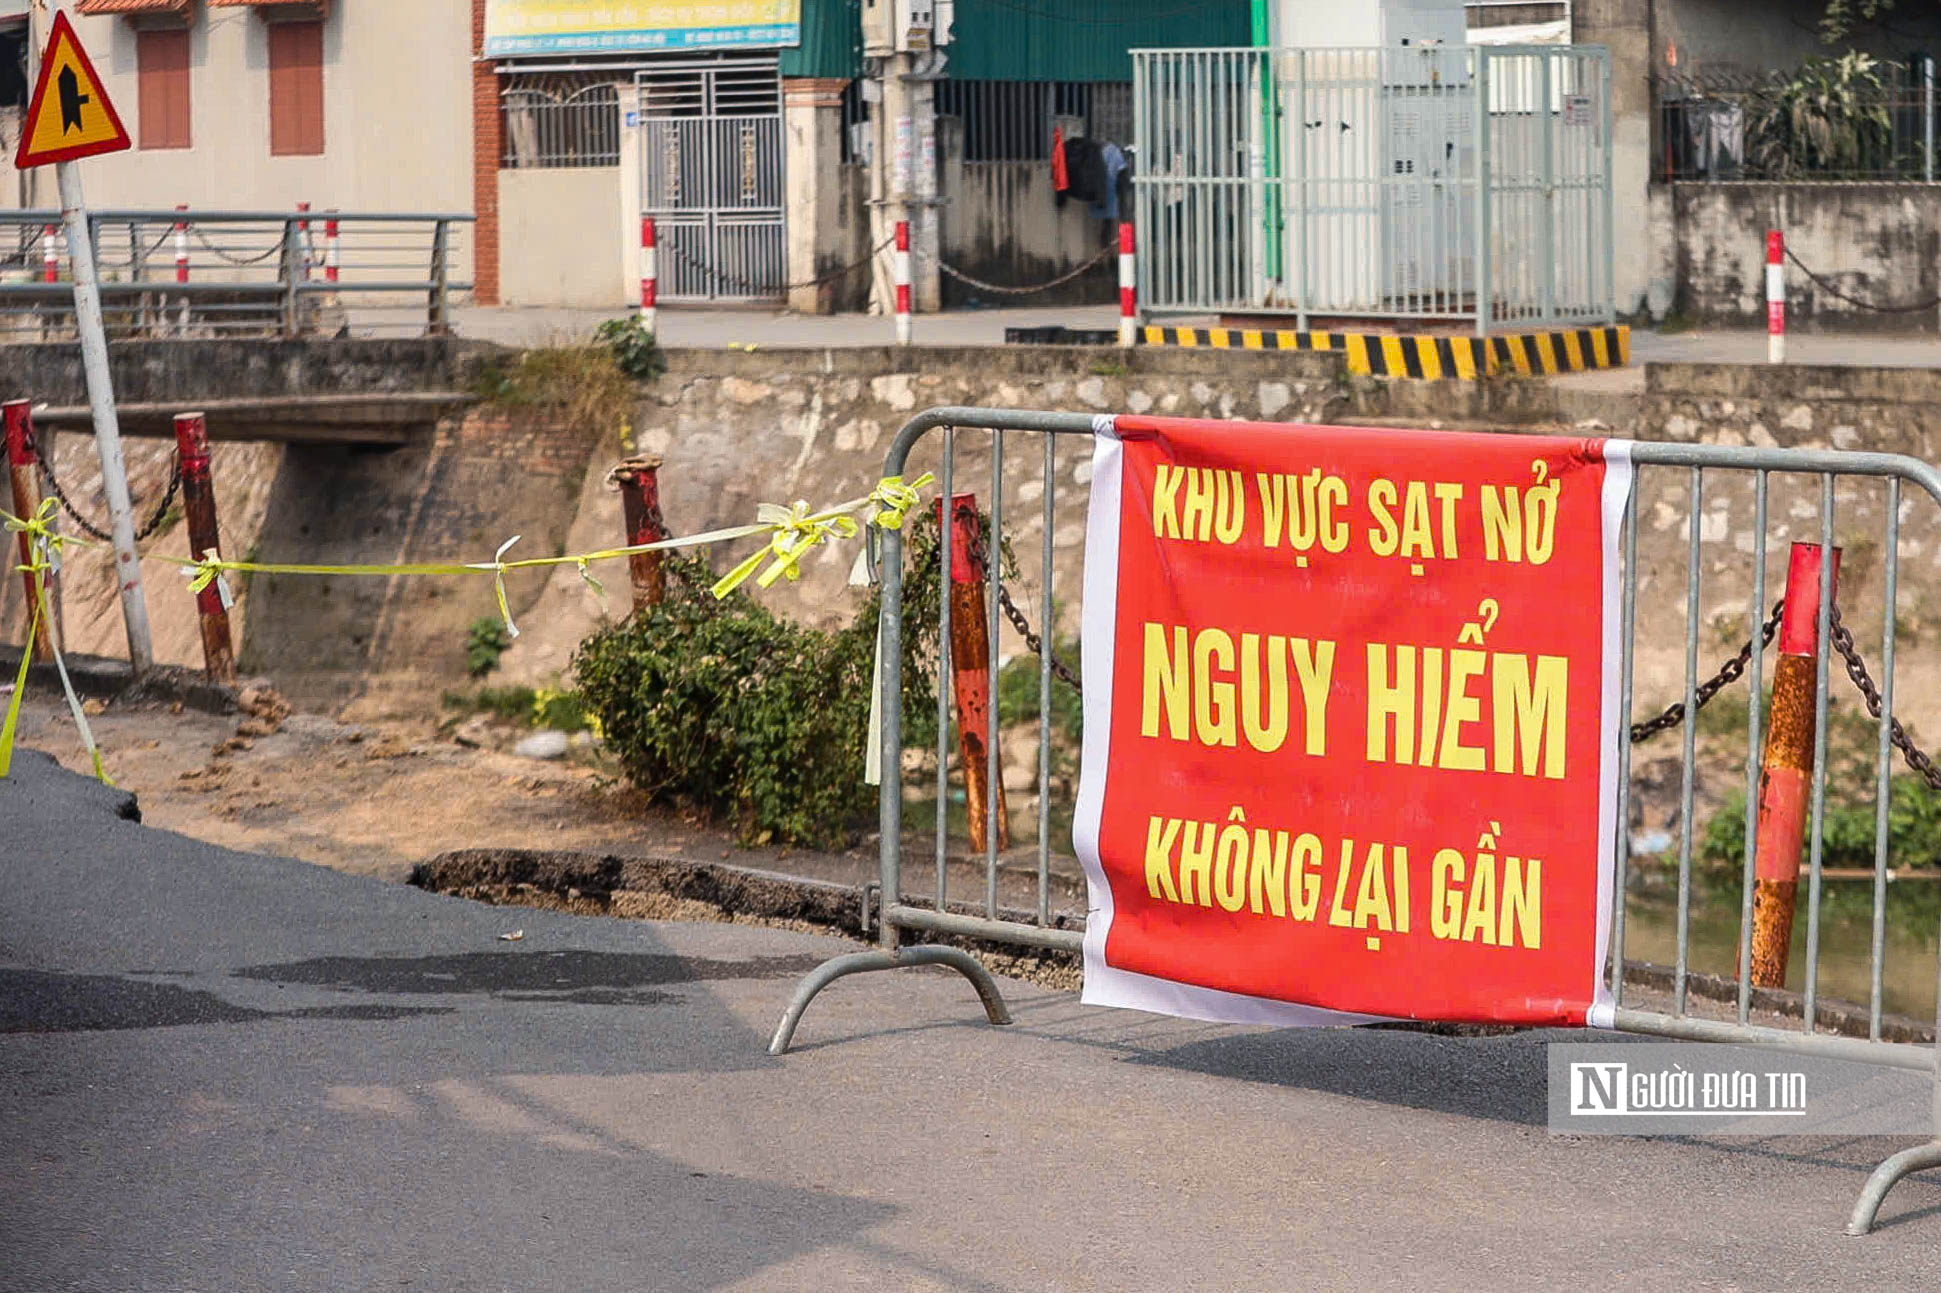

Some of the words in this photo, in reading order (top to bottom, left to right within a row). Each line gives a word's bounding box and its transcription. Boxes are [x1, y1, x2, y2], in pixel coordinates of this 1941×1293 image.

[1152, 464, 1245, 545] KHU
[1256, 467, 1349, 568] VỰC
[1368, 478, 1463, 576] SẠT
[1480, 459, 1561, 565] NỞ
[1141, 622, 1336, 756] NGUY
[1366, 598, 1568, 780] HIỂM
[1144, 806, 1323, 922] KHÔNG
[1328, 839, 1410, 951] LẠI
[1430, 821, 1541, 950] GẦN
